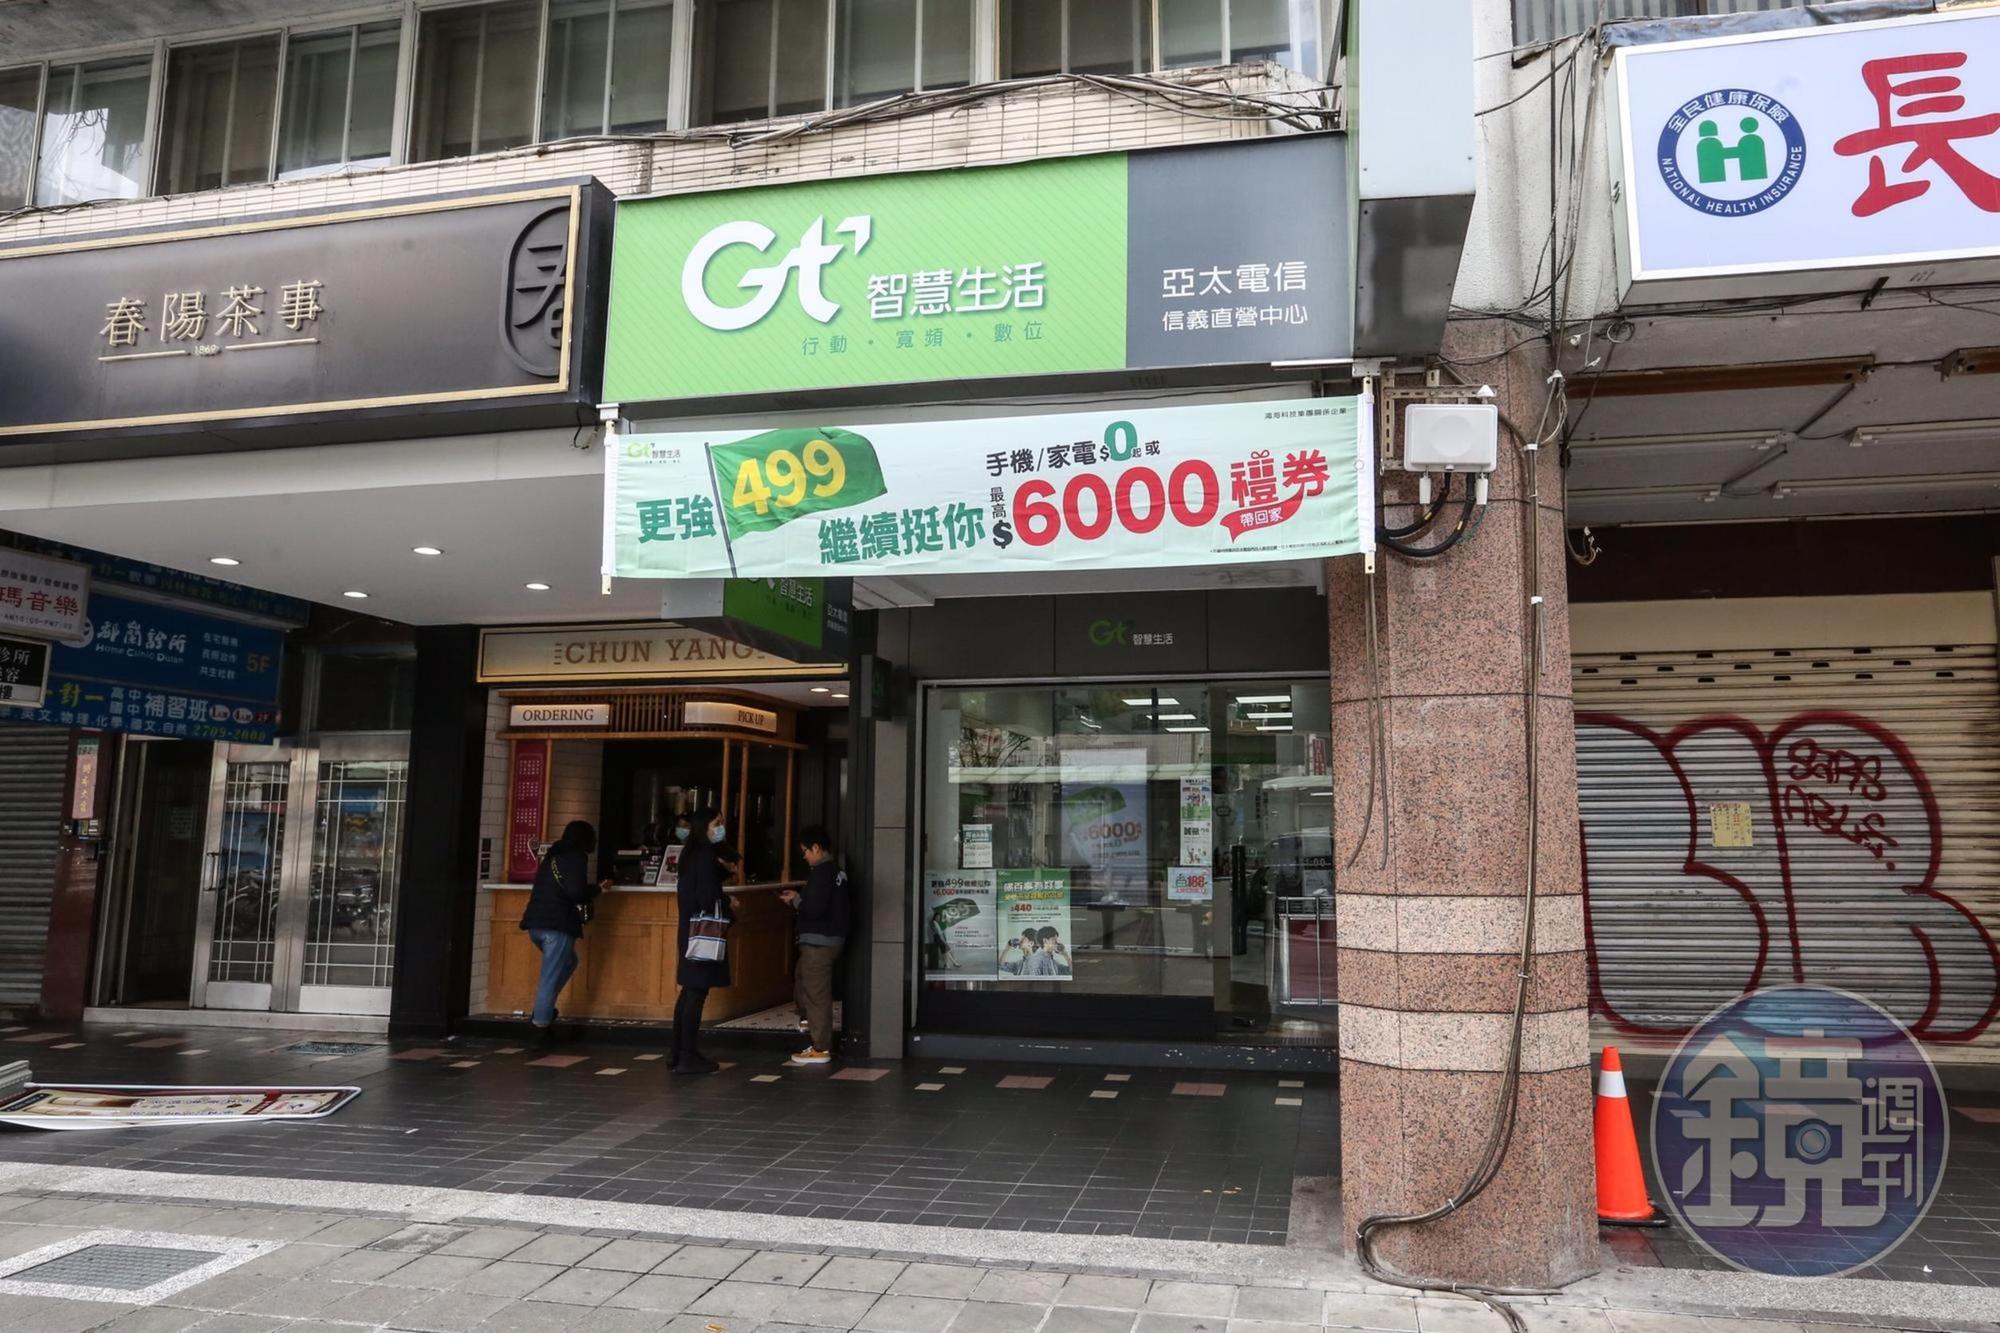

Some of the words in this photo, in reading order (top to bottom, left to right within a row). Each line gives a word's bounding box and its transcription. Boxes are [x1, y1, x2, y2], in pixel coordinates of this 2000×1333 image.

[1668, 91, 1790, 134] 全民健康保險
[1833, 52, 2000, 217] 長
[1662, 157, 1701, 207] NATIONAL
[1705, 200, 1758, 213] HEALTH
[1760, 145, 1803, 207] INSURANCE
[866, 260, 1045, 320] 智慧生活
[1162, 261, 1308, 298] 亞太電信
[99, 279, 325, 347] 春陽茶事
[1162, 304, 1308, 331] 信義直營中心
[731, 438, 846, 516] 499
[990, 487, 1007, 519] 最高
[1230, 449, 1331, 508] 禮券
[635, 494, 717, 544] 更強
[817, 502, 986, 565] 繼續挺你
[1240, 509, 1284, 527] 帶回家
[565, 640, 653, 664] CHUN
[664, 638, 754, 662] YANG
[1132, 632, 1174, 646] 智慧生活
[143, 692, 209, 722] 補習班
[523, 709, 594, 722] ORDERING
[737, 710, 754, 723] PICK
